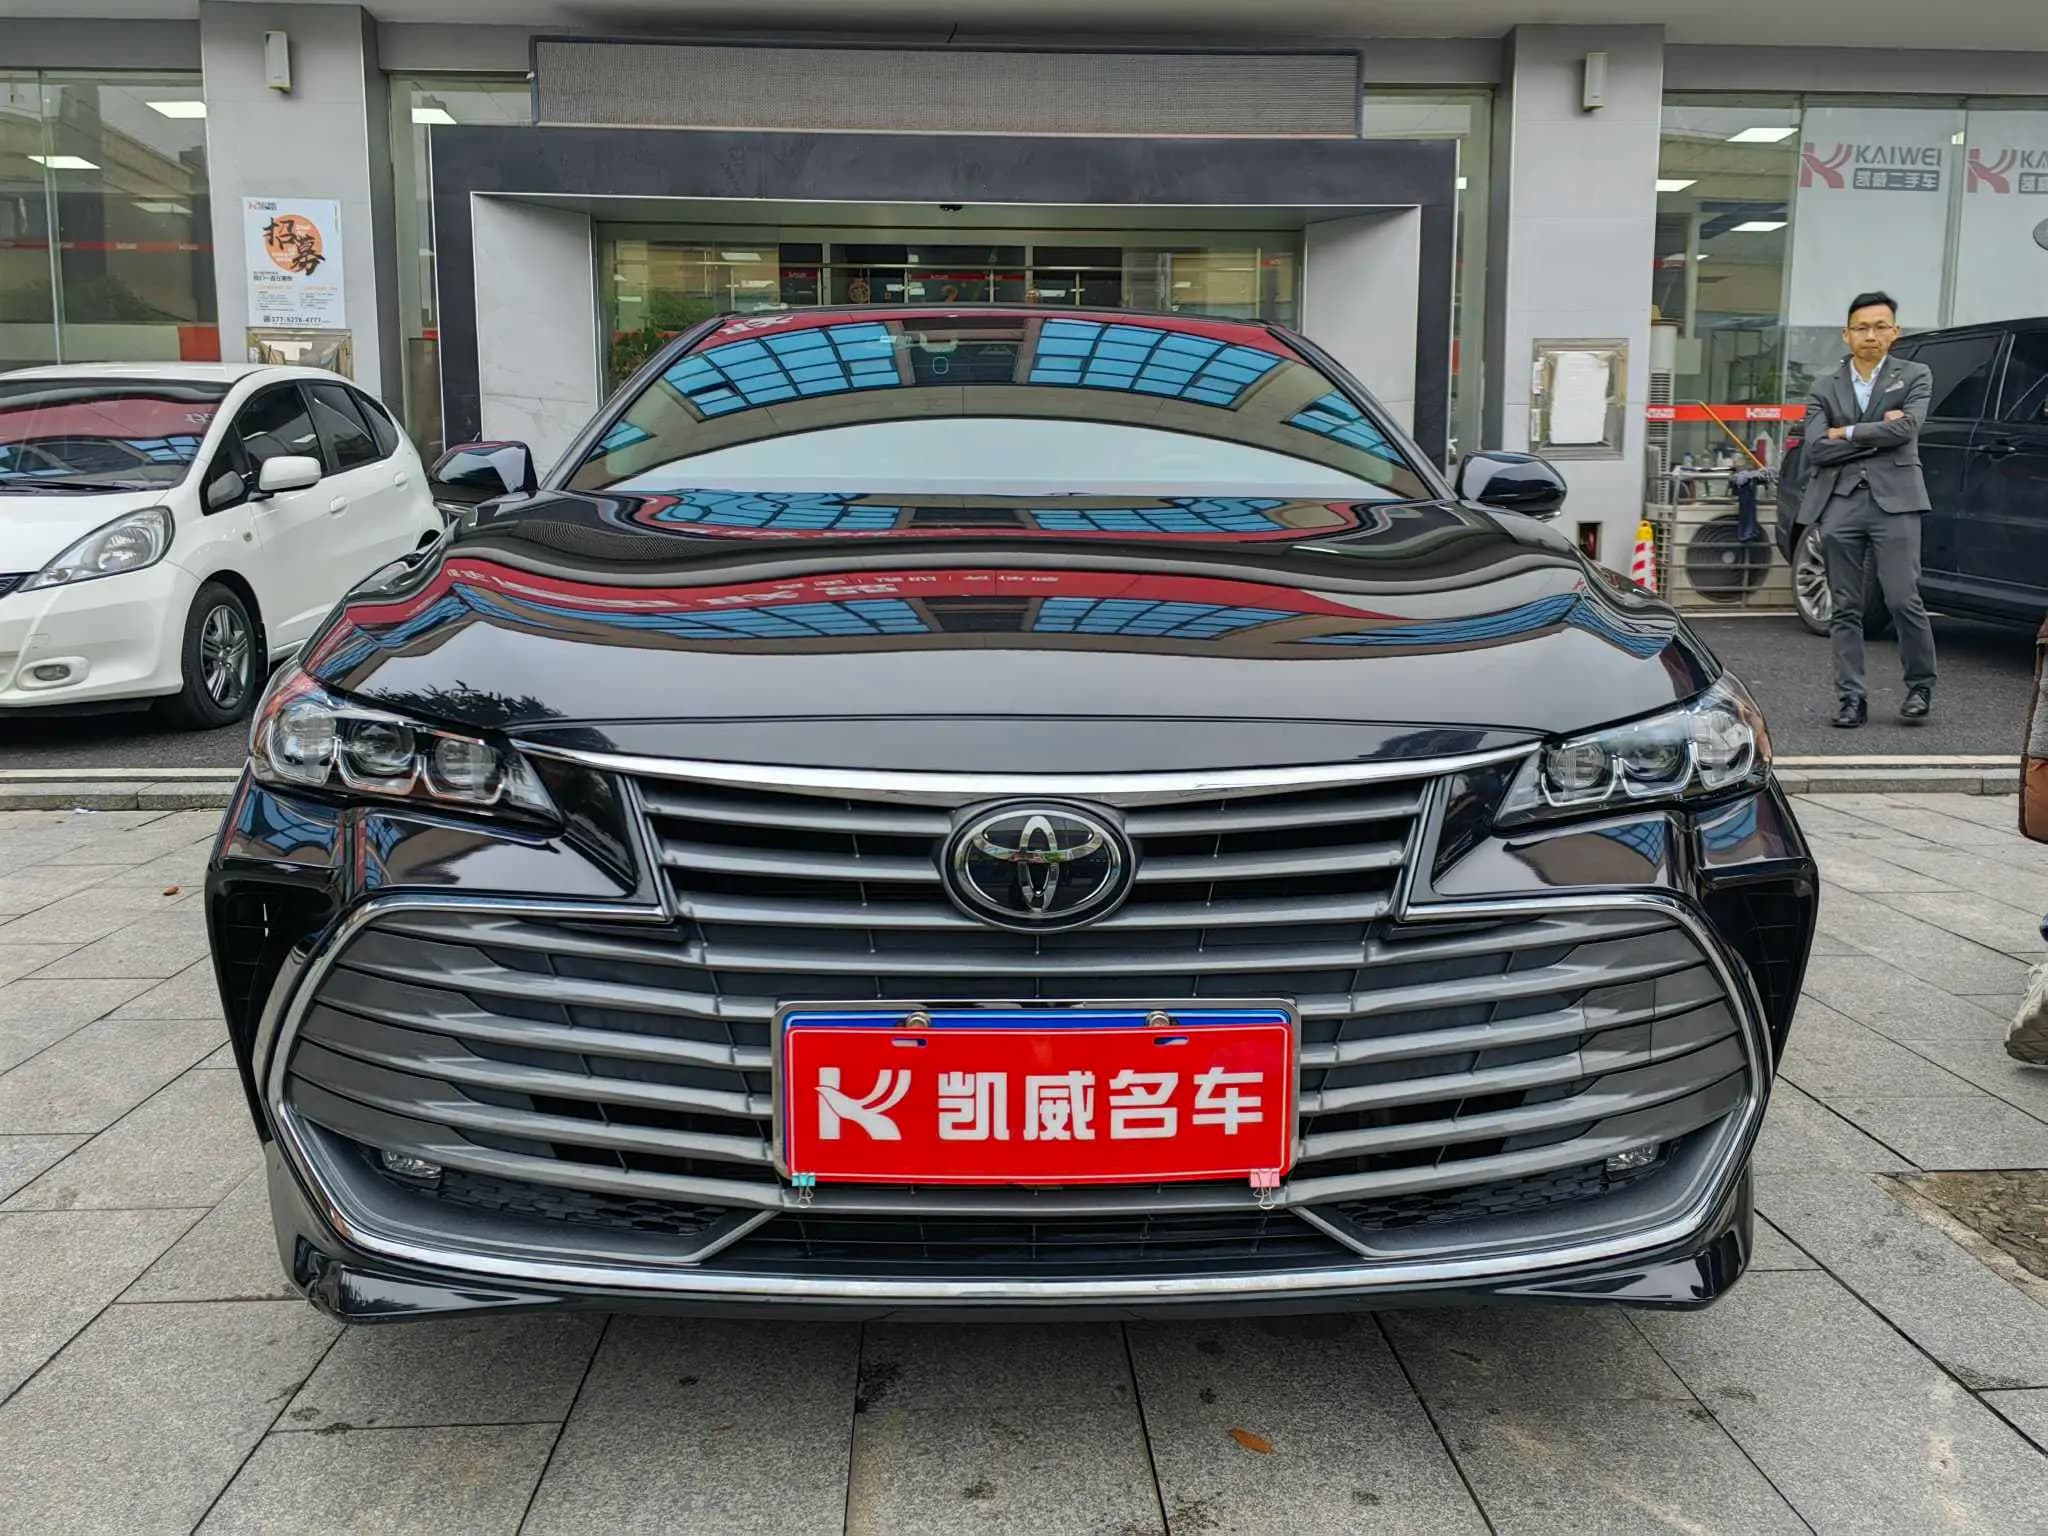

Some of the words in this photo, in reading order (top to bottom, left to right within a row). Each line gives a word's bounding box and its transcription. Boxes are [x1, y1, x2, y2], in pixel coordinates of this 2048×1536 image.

[1855, 144, 1942, 167] KAIWEI
[1855, 169, 1939, 190] 凯威二手车
[937, 1066, 1264, 1140] 凯威名车
